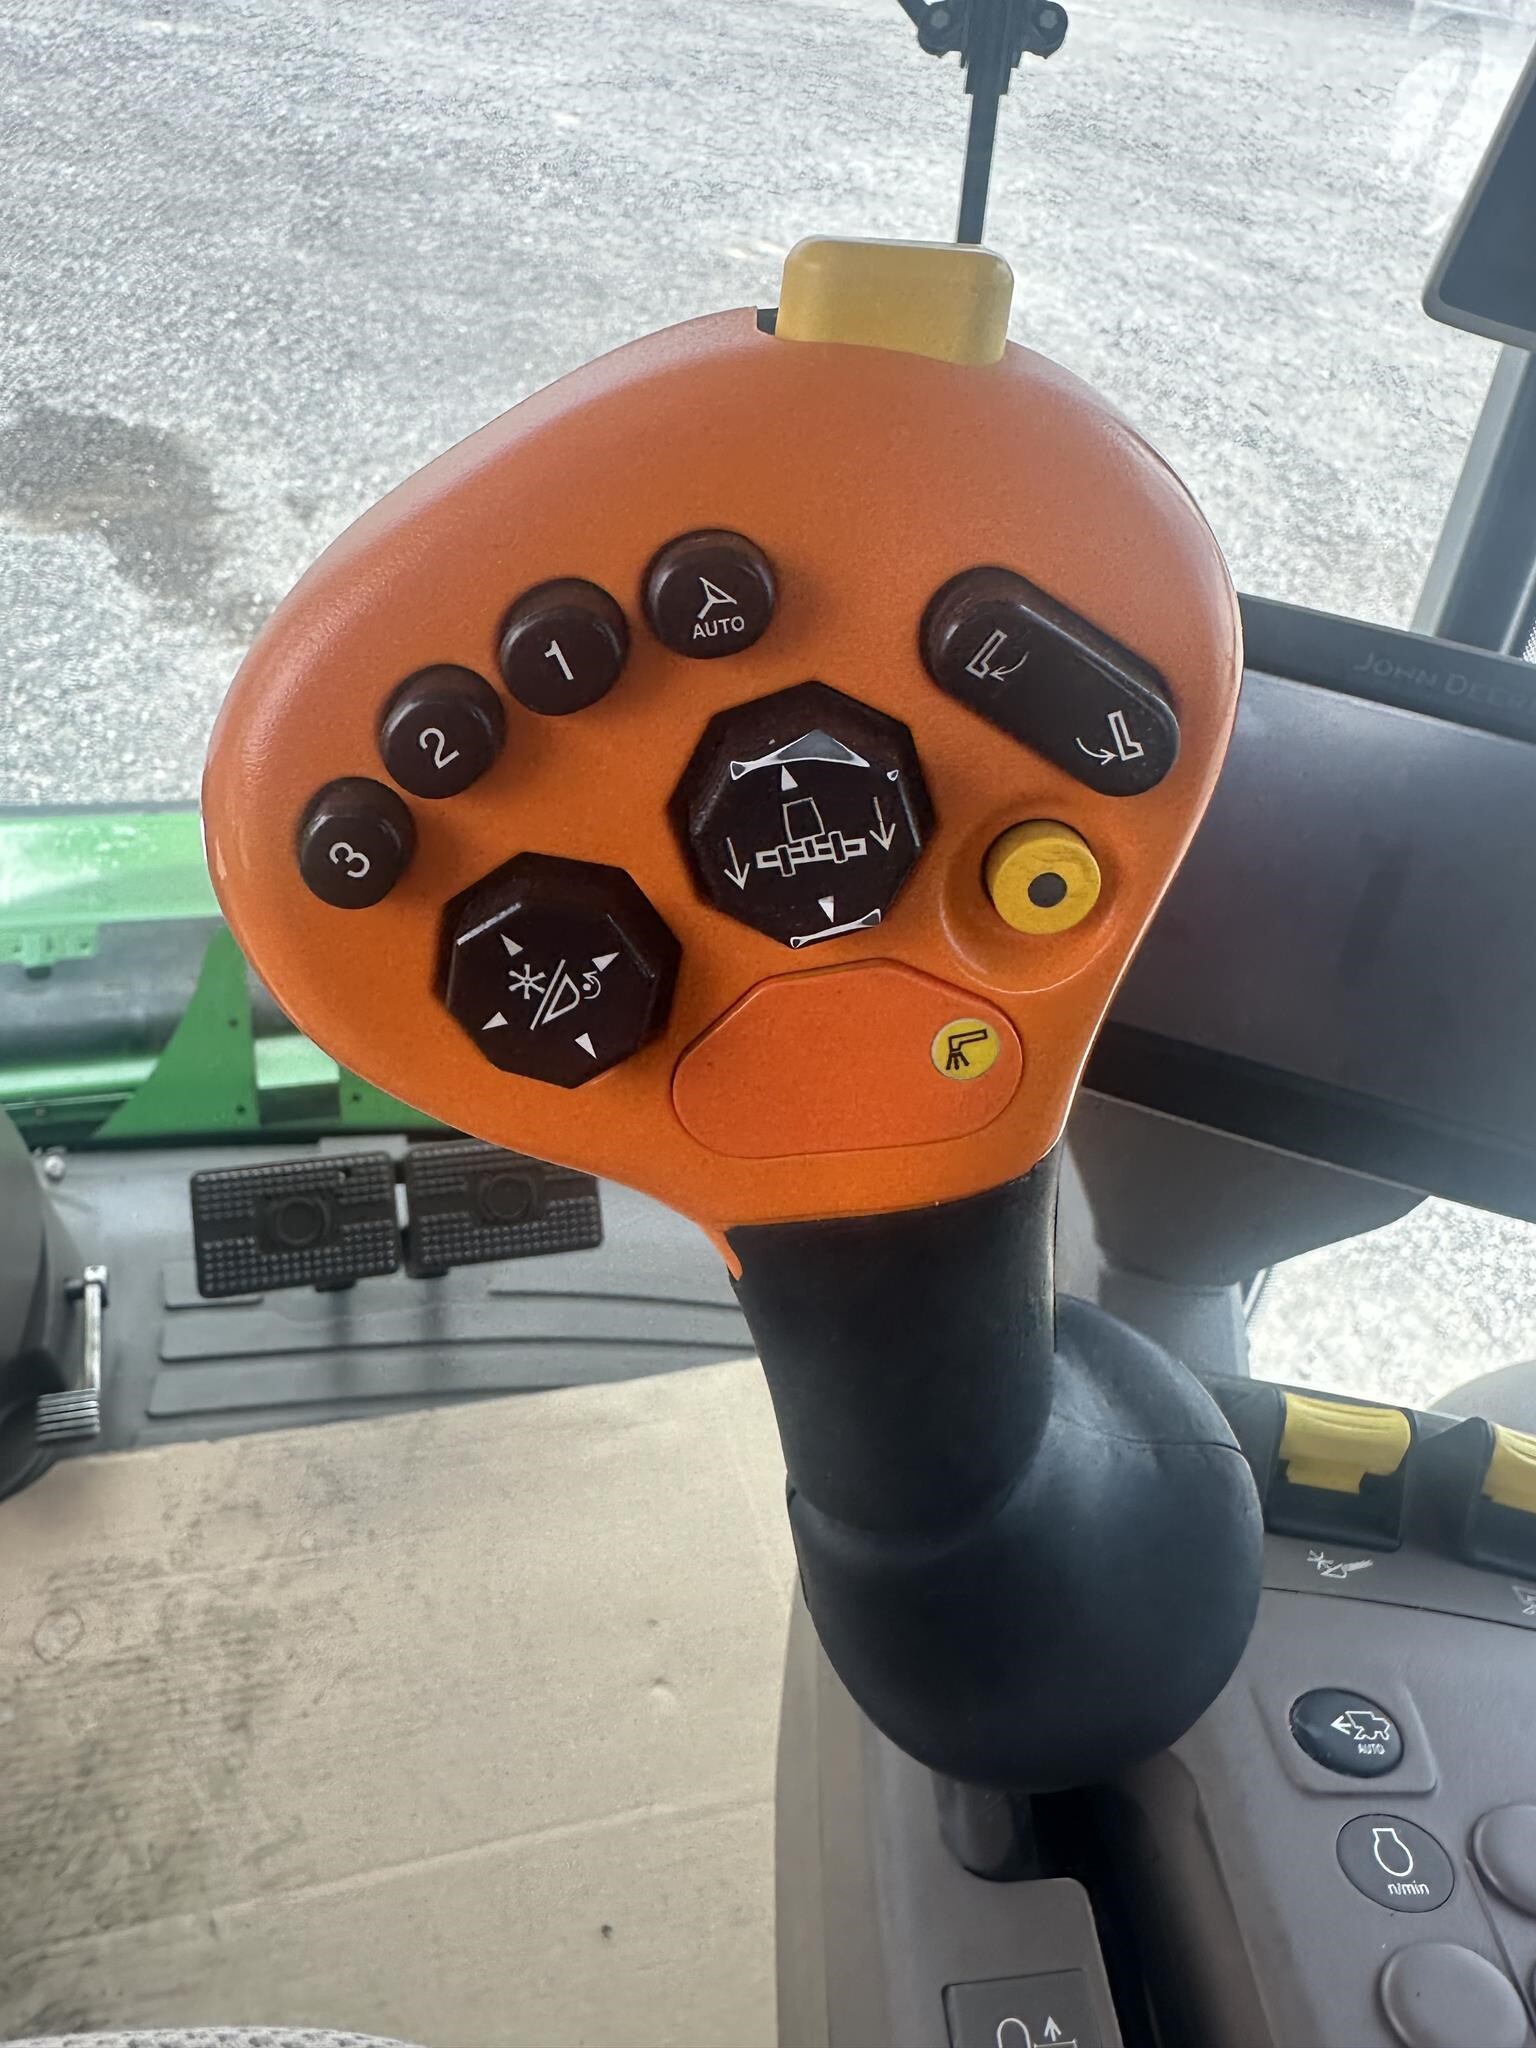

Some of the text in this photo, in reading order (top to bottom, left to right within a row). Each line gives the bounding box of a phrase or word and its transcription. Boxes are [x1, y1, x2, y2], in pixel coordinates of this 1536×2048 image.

[692, 615, 746, 640] AUTO
[544, 640, 574, 681] 1
[1353, 651, 1438, 688] JOHN
[419, 727, 460, 769] 2
[329, 842, 370, 879] 3
[1358, 1743, 1385, 1755] AUTO
[1388, 1880, 1430, 1896] n/min
